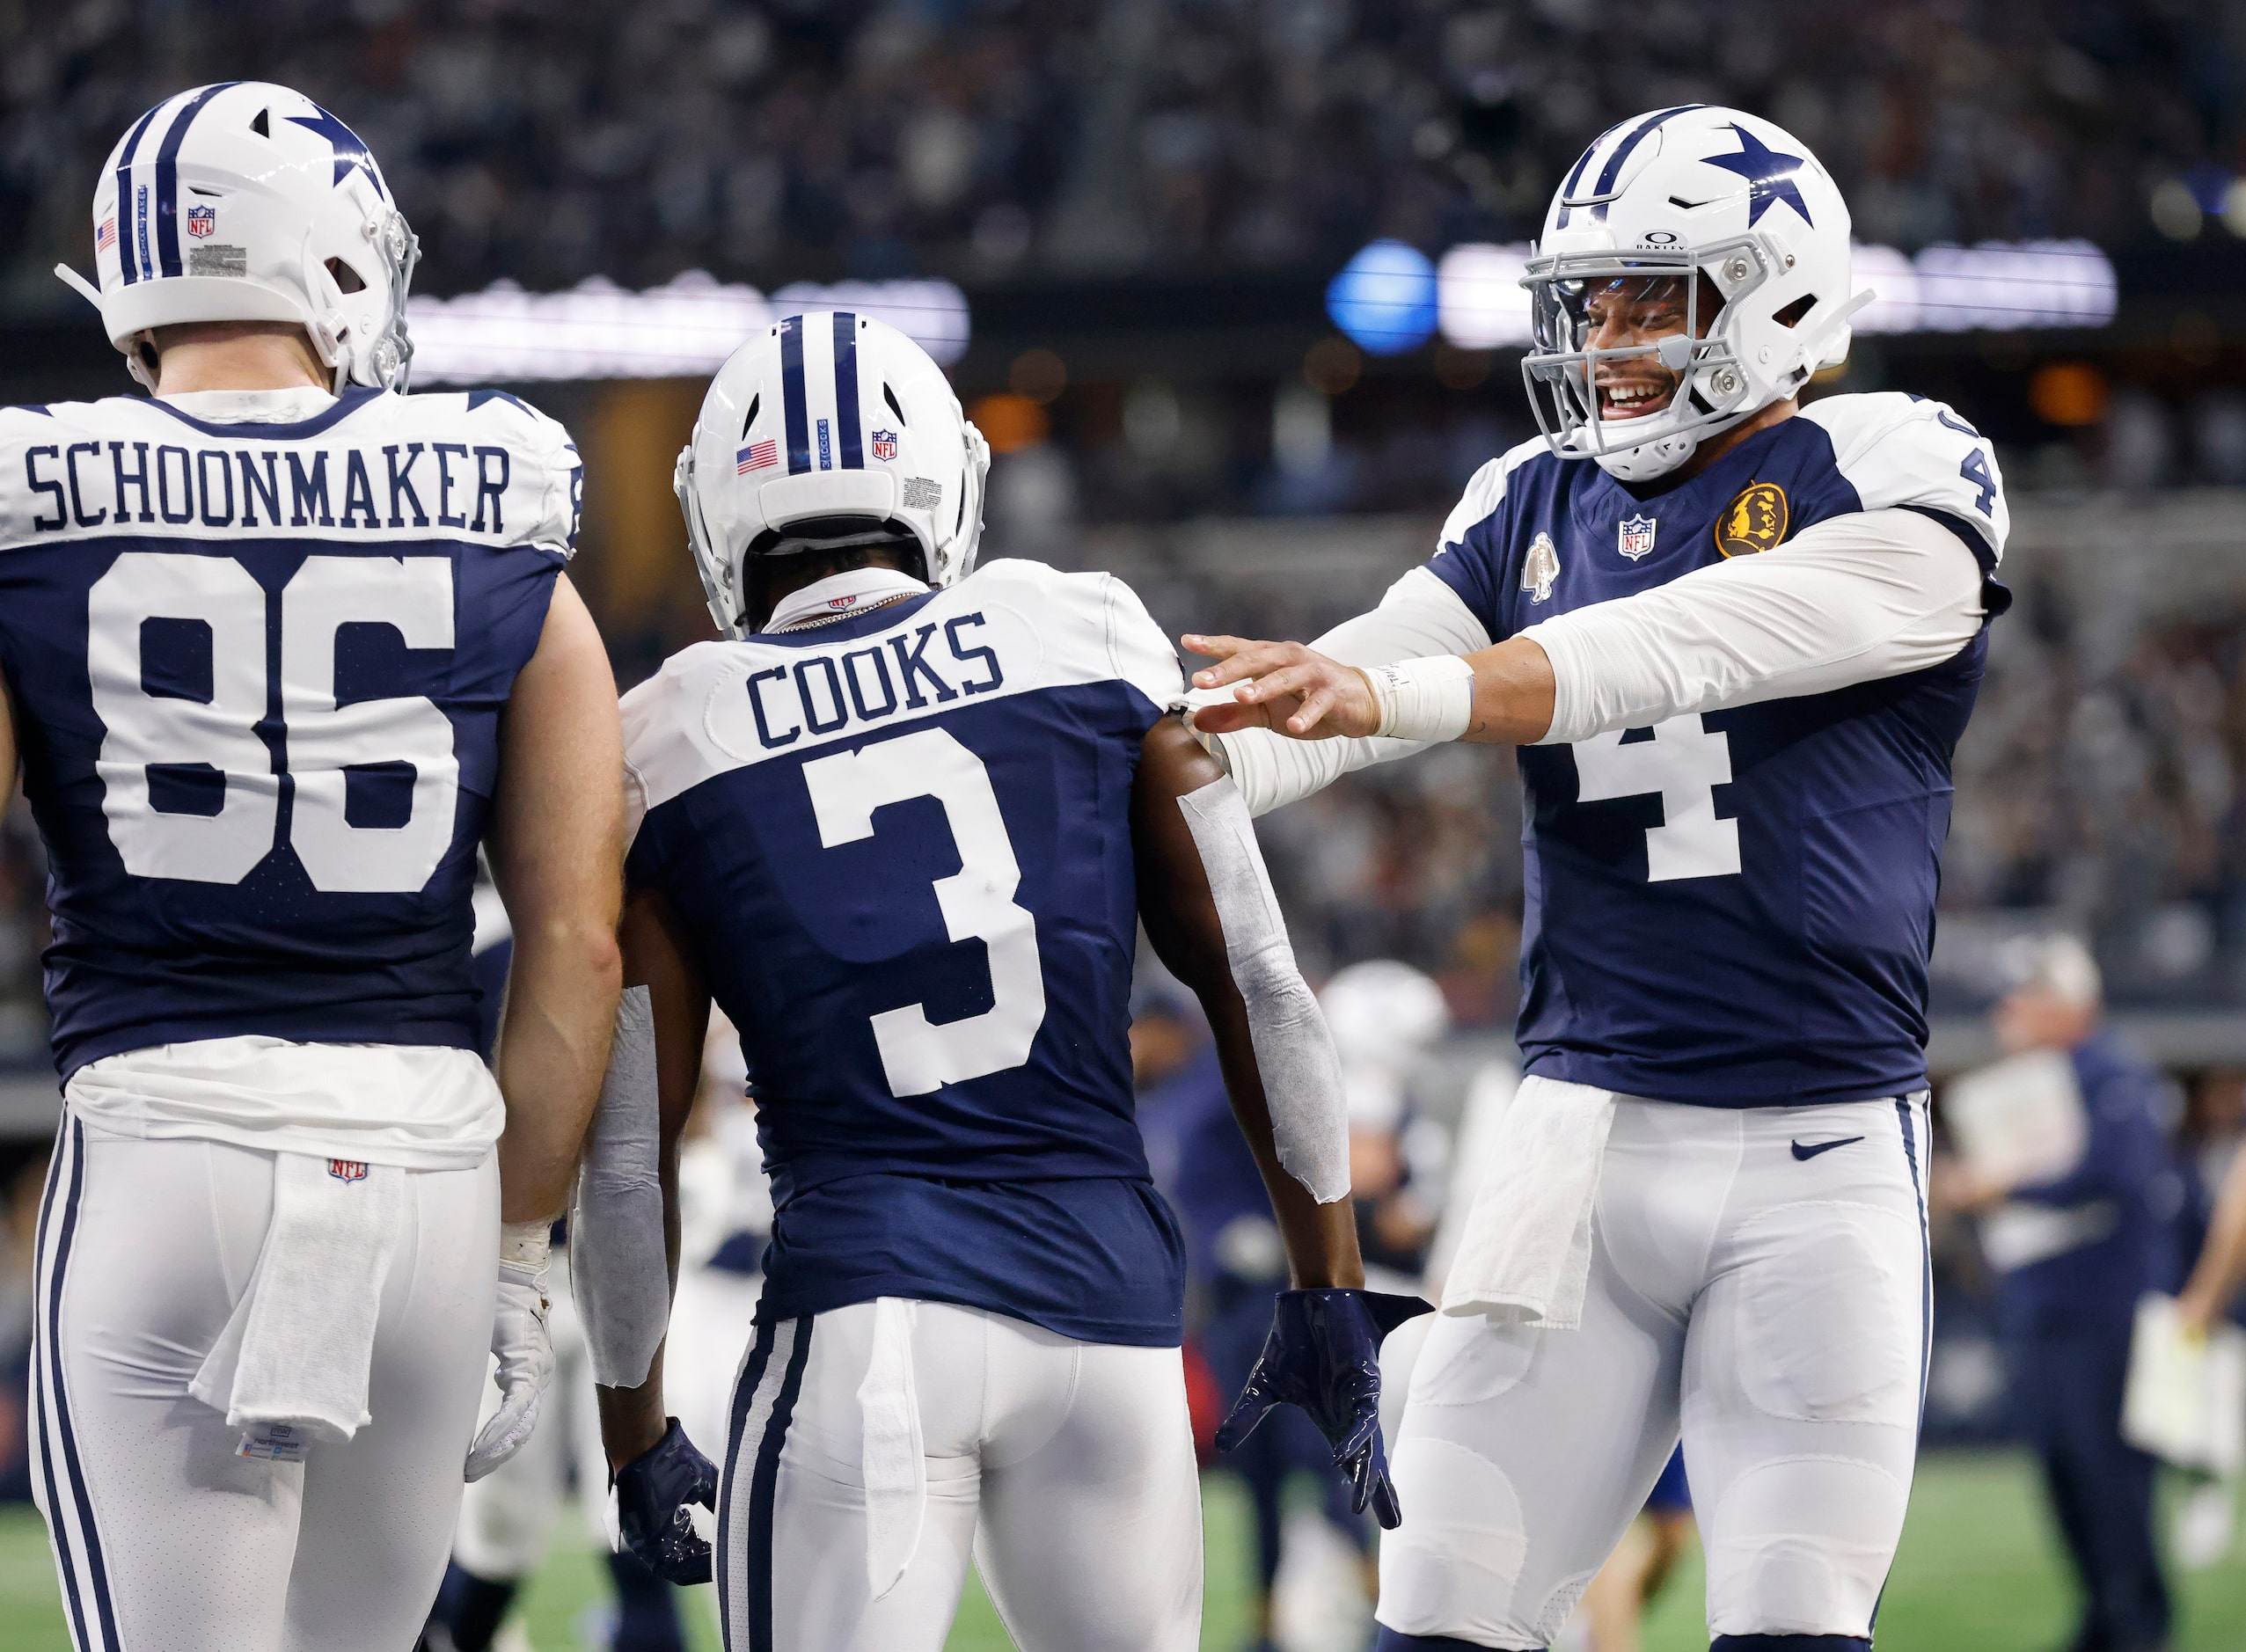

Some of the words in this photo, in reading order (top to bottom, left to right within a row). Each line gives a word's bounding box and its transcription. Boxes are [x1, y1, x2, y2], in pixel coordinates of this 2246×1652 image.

[190, 219, 212, 235] NFL
[26, 442, 509, 534] SCHOONMAKER
[874, 442, 895, 458] NFL
[1959, 447, 1996, 518] 4
[1624, 535, 1648, 550] NFL
[745, 612, 1004, 749] COOKS
[87, 552, 460, 893] 86
[1571, 713, 1742, 882] 4
[801, 727, 1046, 1098] 3
[332, 1159, 364, 1180] NFL
